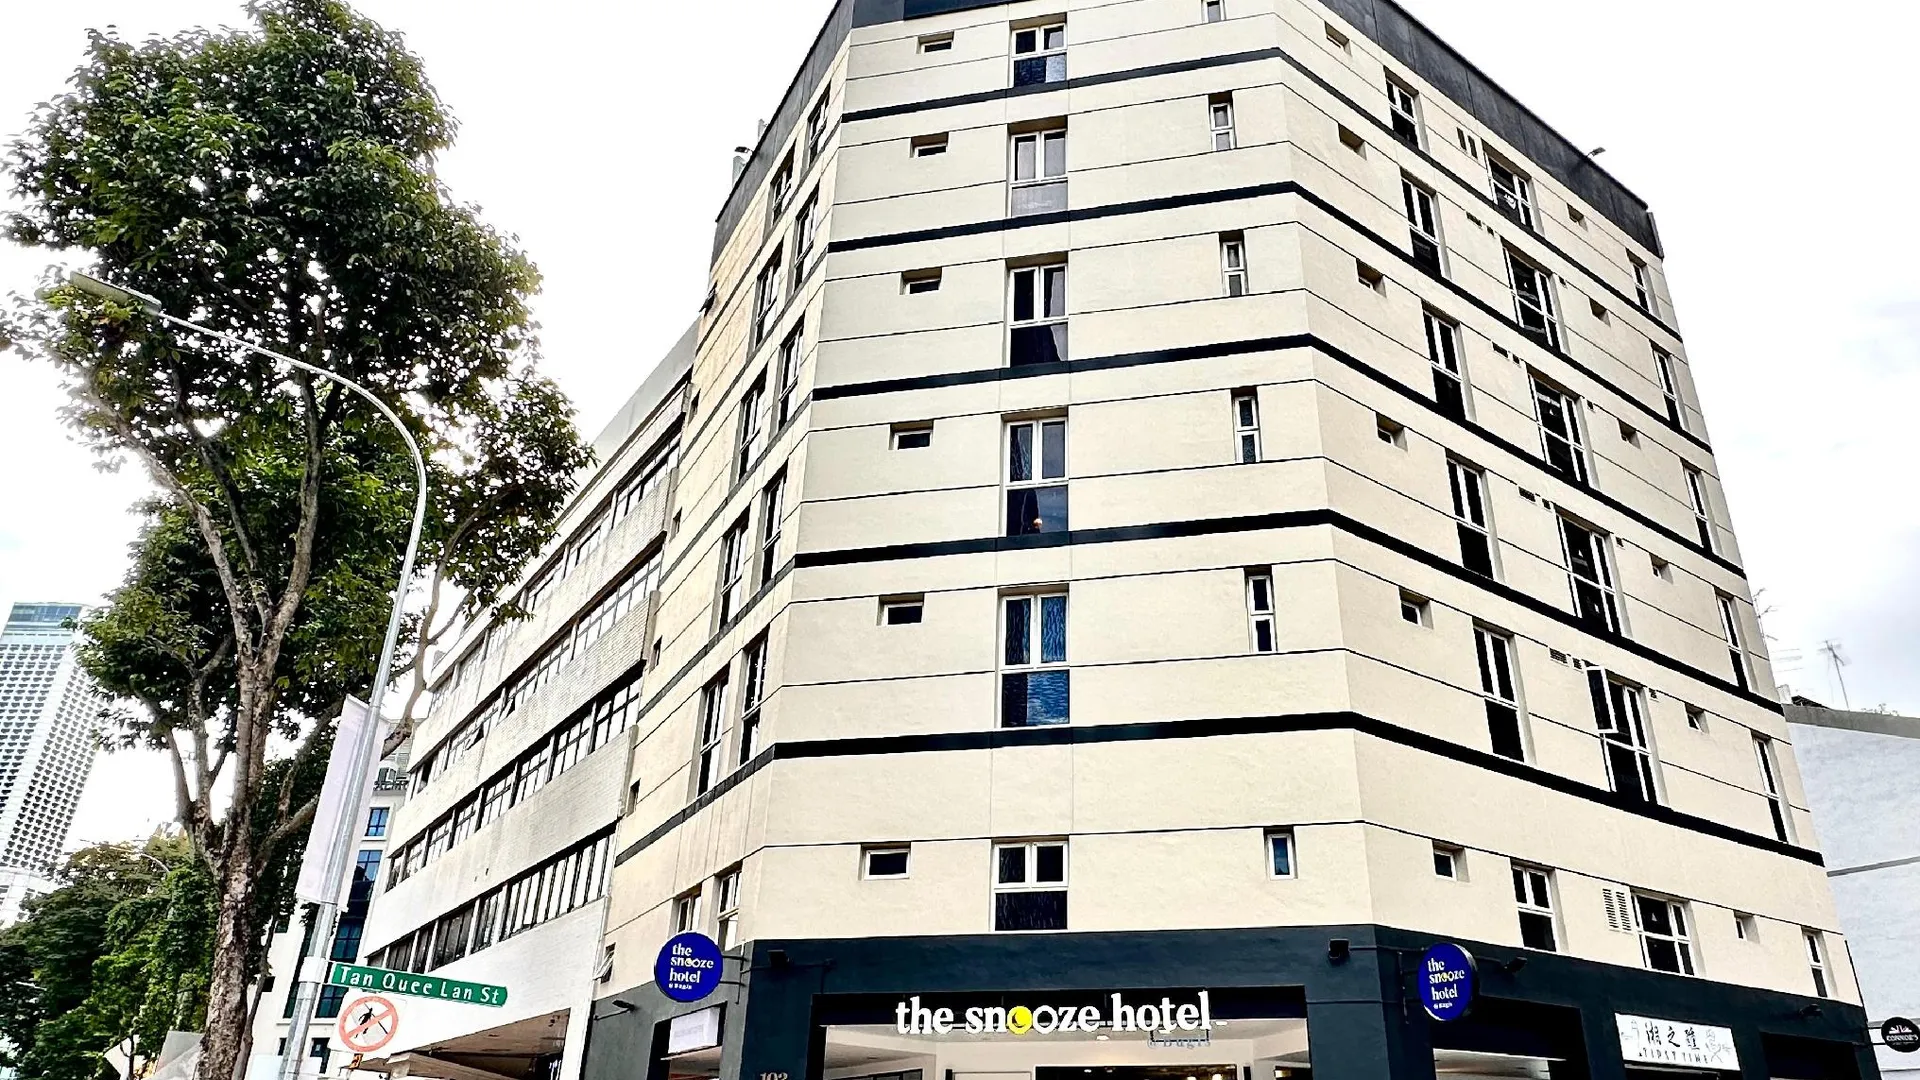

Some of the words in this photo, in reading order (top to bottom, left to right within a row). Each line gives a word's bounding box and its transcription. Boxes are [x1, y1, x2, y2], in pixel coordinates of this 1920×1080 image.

[672, 943, 693, 956] the
[670, 957, 714, 969] snooze
[1427, 957, 1445, 972] the
[669, 968, 701, 983] hotel
[1429, 969, 1465, 984] snooze
[340, 966, 373, 987] Tan
[382, 972, 433, 994] Quee
[440, 982, 472, 1001] Lan
[480, 987, 500, 1004] St
[1431, 983, 1458, 1000] hotel
[895, 996, 954, 1035] the
[965, 1004, 1100, 1035] snooze
[1111, 990, 1211, 1033] hotel
